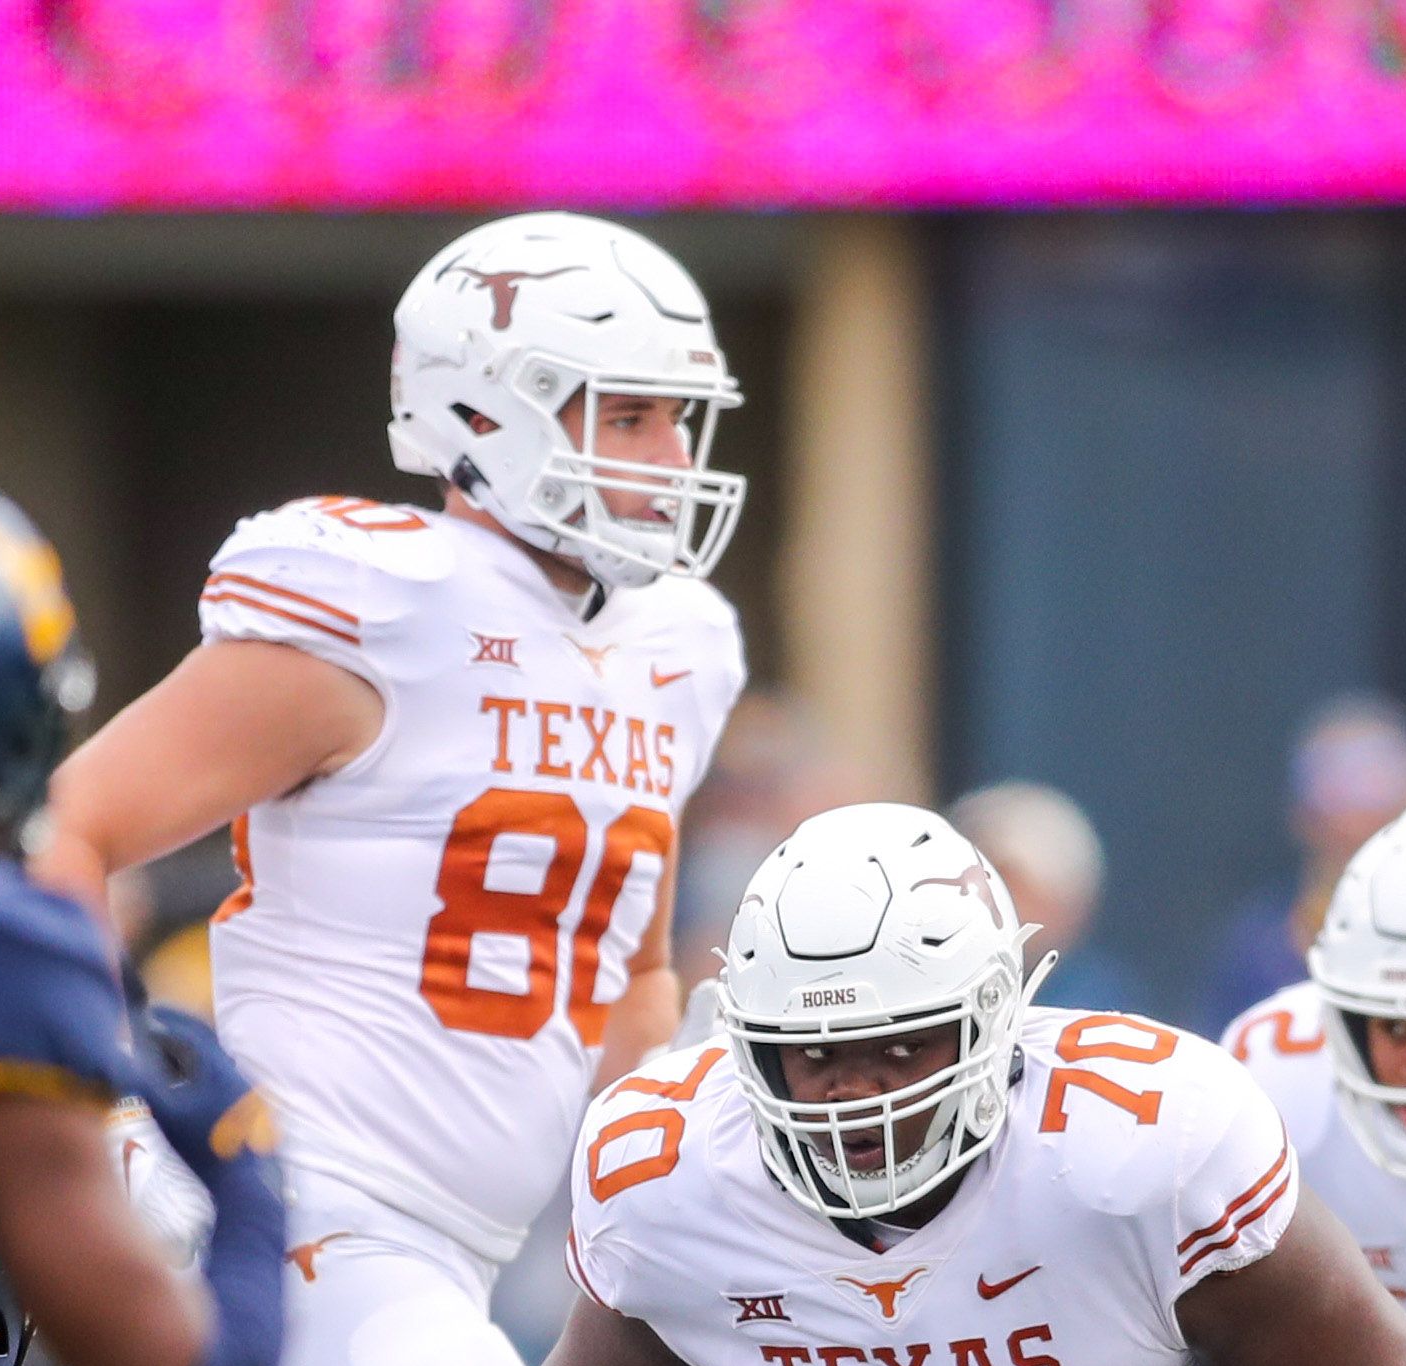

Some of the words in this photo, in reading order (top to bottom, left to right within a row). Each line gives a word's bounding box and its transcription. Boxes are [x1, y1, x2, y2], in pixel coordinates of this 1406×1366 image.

[480, 696, 676, 798] TEXAS
[419, 787, 676, 1049] 80
[801, 987, 857, 1008] HORNS
[1039, 1014, 1179, 1134] 70
[726, 1293, 793, 1325] XII
